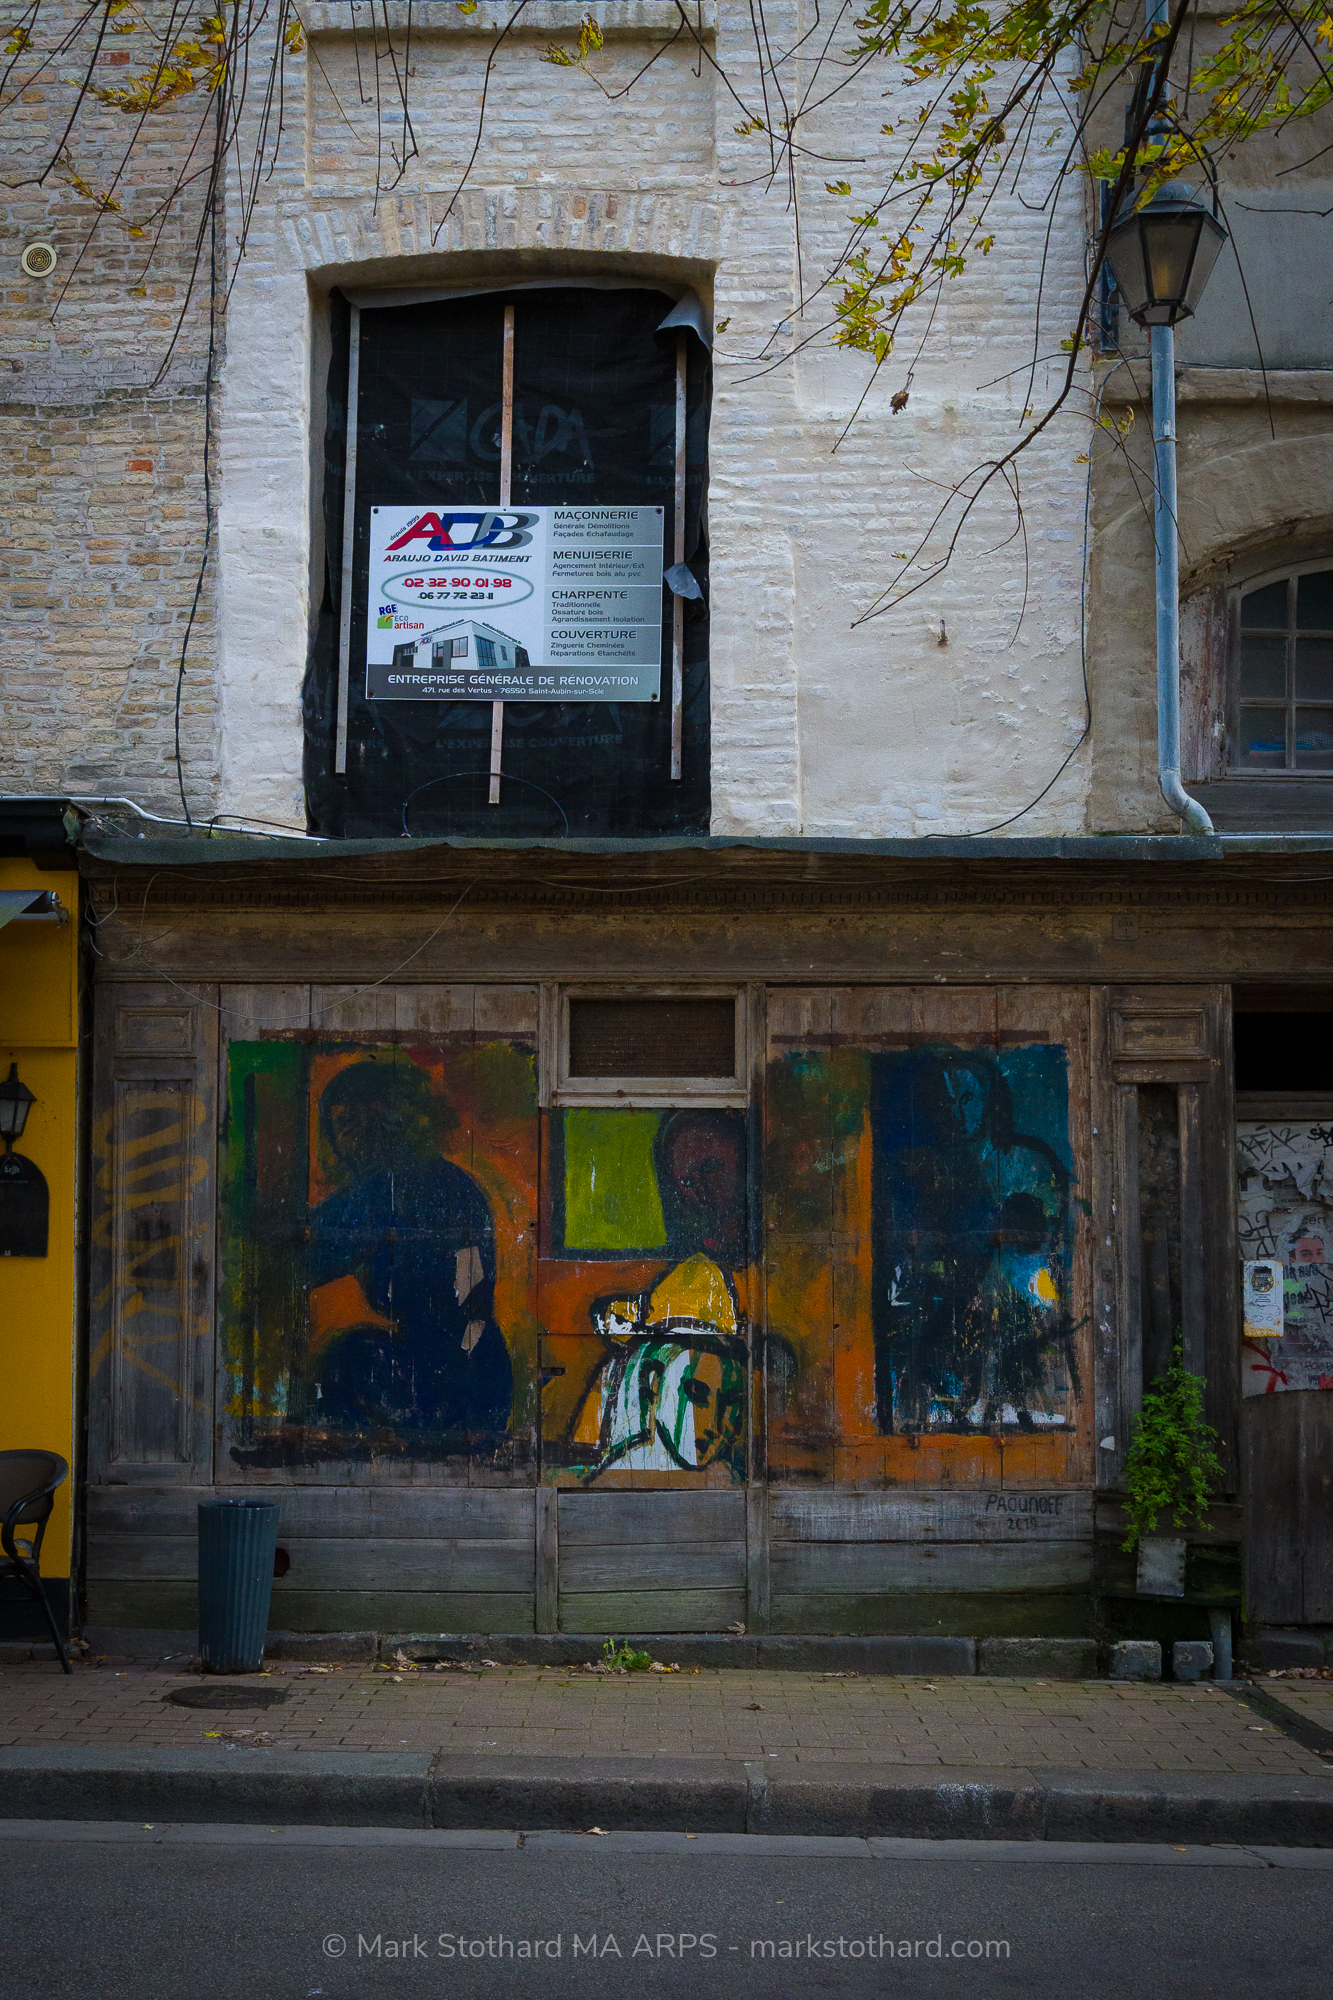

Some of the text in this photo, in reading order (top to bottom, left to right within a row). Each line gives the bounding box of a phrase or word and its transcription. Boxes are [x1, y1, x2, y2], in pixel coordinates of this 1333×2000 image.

[554, 511, 639, 521] MAÇONNERIE
[385, 511, 540, 552] ADB
[389, 515, 420, 541] depuis 1999
[383, 554, 532, 563] ARAUJO DAVID BATIMENT
[553, 551, 633, 559] MENUISERIE
[404, 578, 512, 588] 02 32 90 01 98
[420, 592, 494, 600] 06 77 72 23 11
[552, 590, 628, 599] CHARPENTE
[378, 604, 397, 615] RGE
[394, 621, 424, 629] artisan
[551, 630, 638, 639] COUVERTURE
[387, 673, 639, 685] ENTREPRISE GÉNÉRALE DE RÉNOVATION
